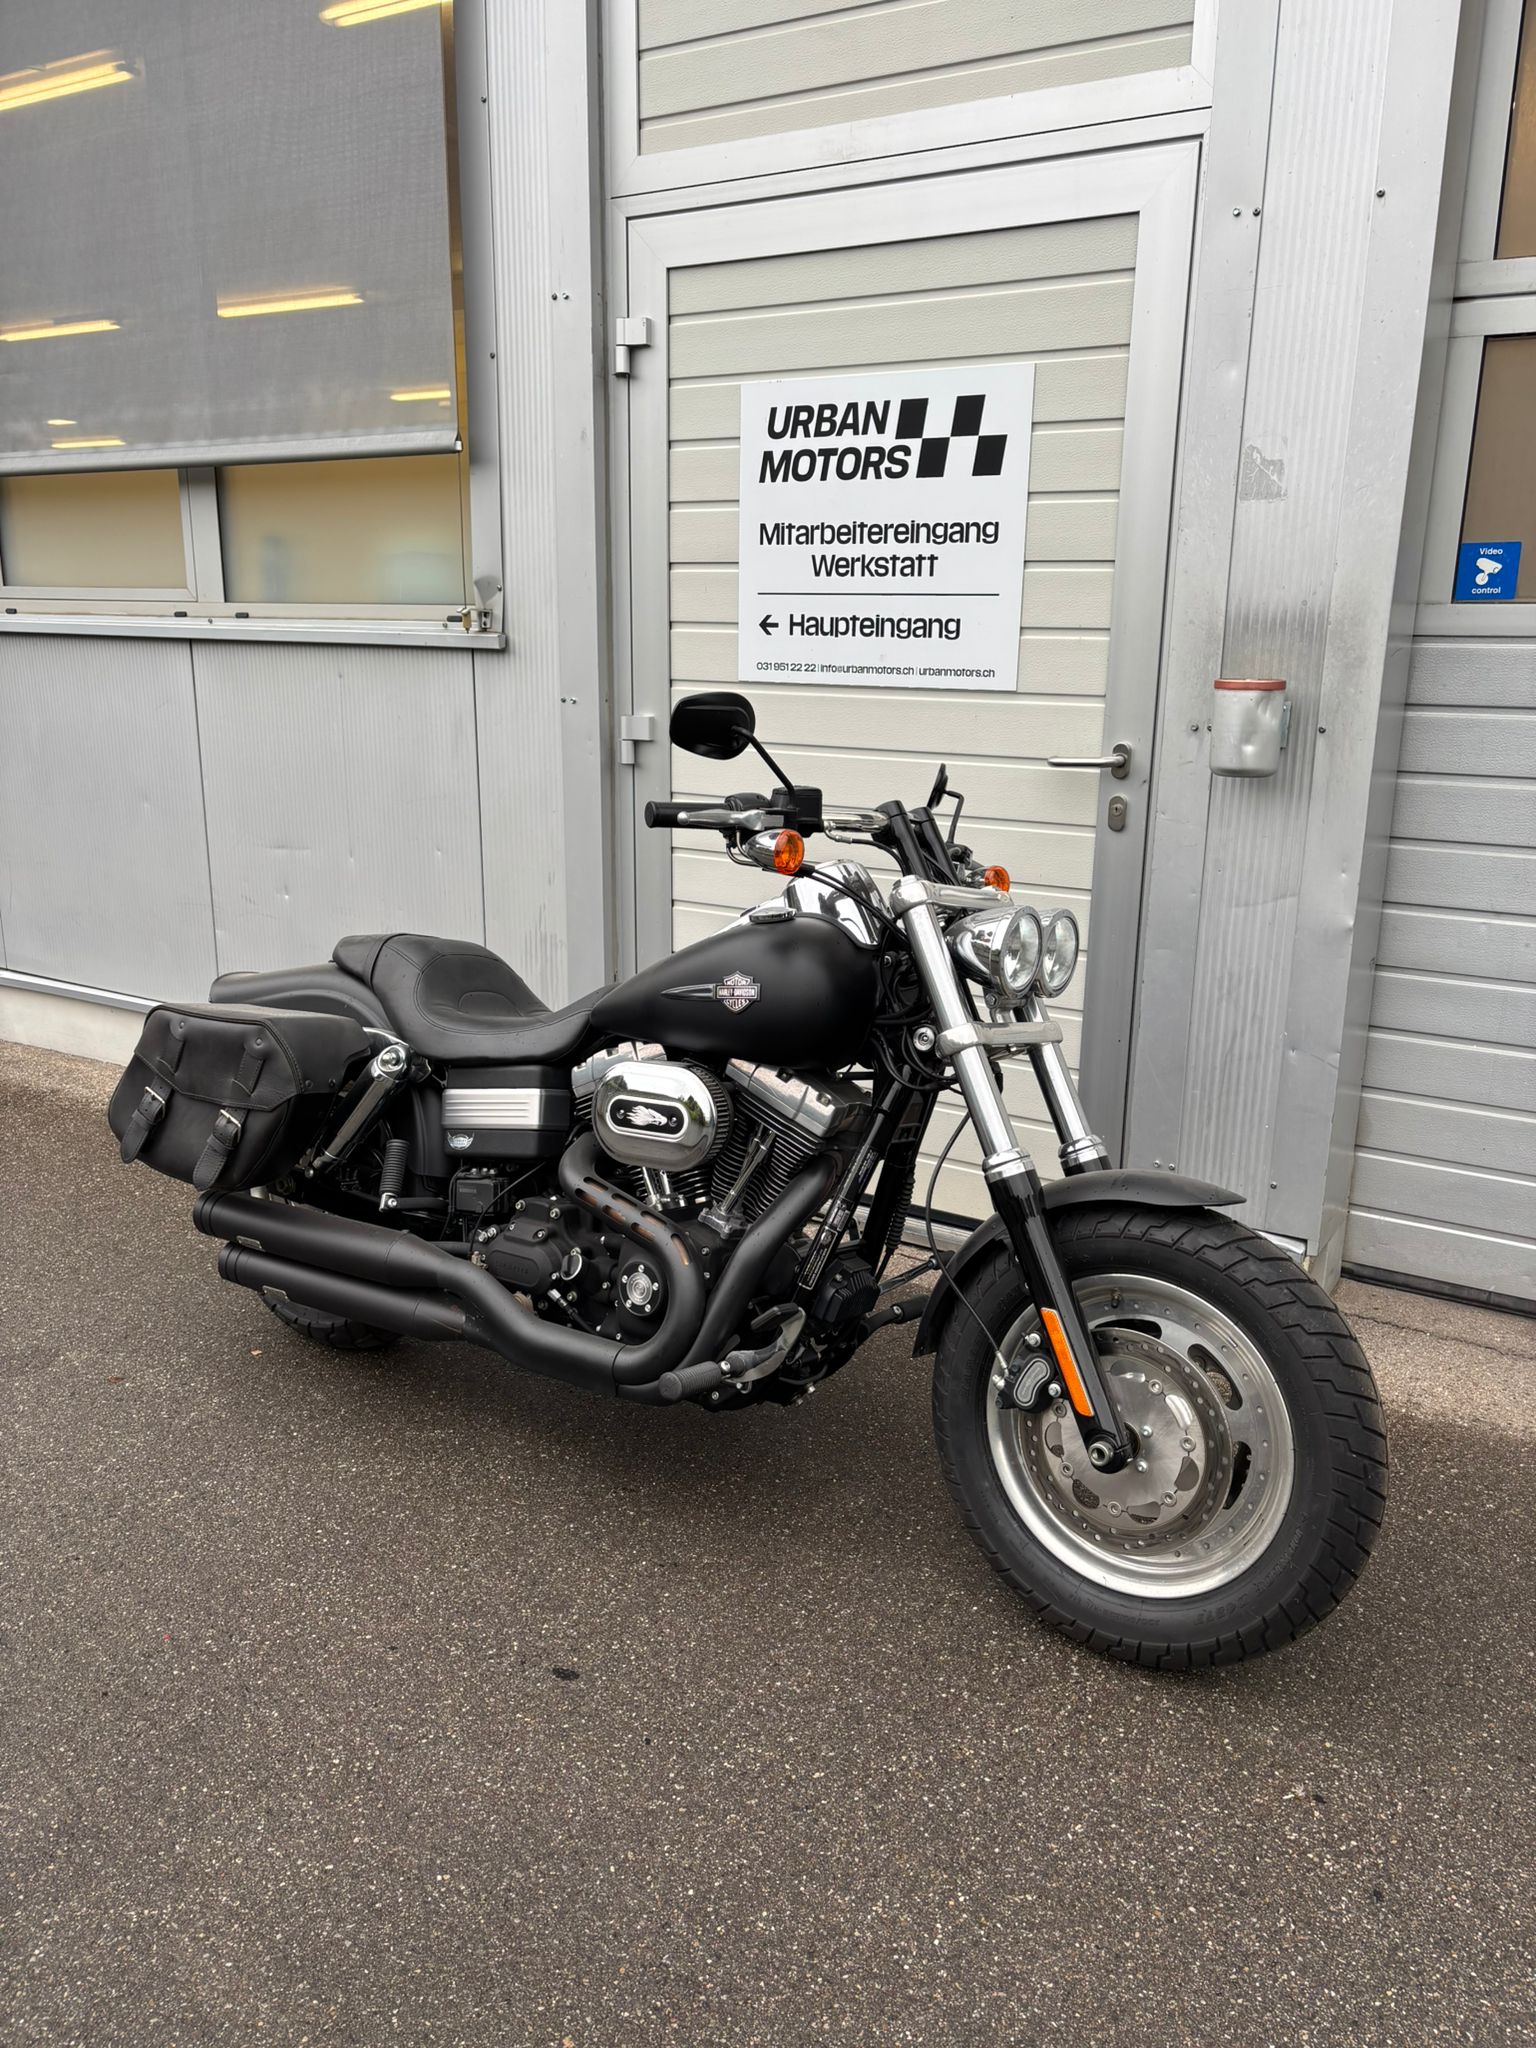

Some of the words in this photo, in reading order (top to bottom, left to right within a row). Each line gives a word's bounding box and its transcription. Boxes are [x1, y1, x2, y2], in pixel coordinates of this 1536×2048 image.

[767, 399, 891, 440] URBAN
[758, 444, 912, 484] MOTORS
[759, 519, 1000, 546] Mitarbeitereingang
[1479, 547, 1504, 555] Video
[811, 553, 939, 578] Werkstatt
[1471, 586, 1501, 594] control
[788, 613, 961, 641] Haupteingang
[803, 663, 817, 673] 22
[918, 667, 996, 678] urbanmotors.ch
